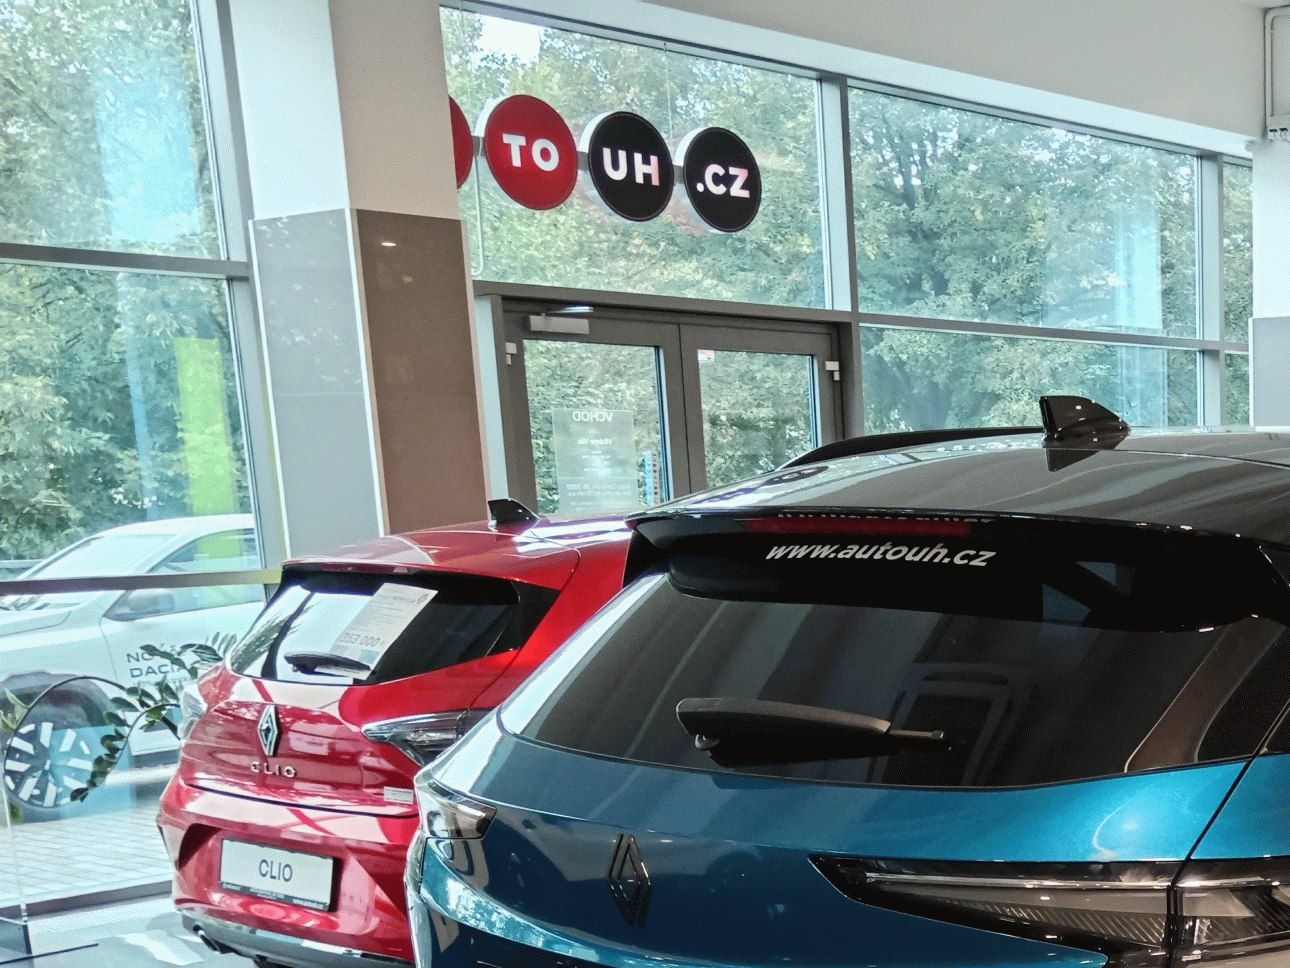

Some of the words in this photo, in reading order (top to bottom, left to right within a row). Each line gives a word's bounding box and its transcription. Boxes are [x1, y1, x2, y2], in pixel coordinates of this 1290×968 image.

[502, 133, 560, 172] TO
[602, 147, 660, 186] UH
[696, 163, 751, 199] .CZ
[765, 541, 997, 567] www.autouh.cz
[251, 761, 297, 778] CLIO
[258, 859, 293, 883] CLIO
